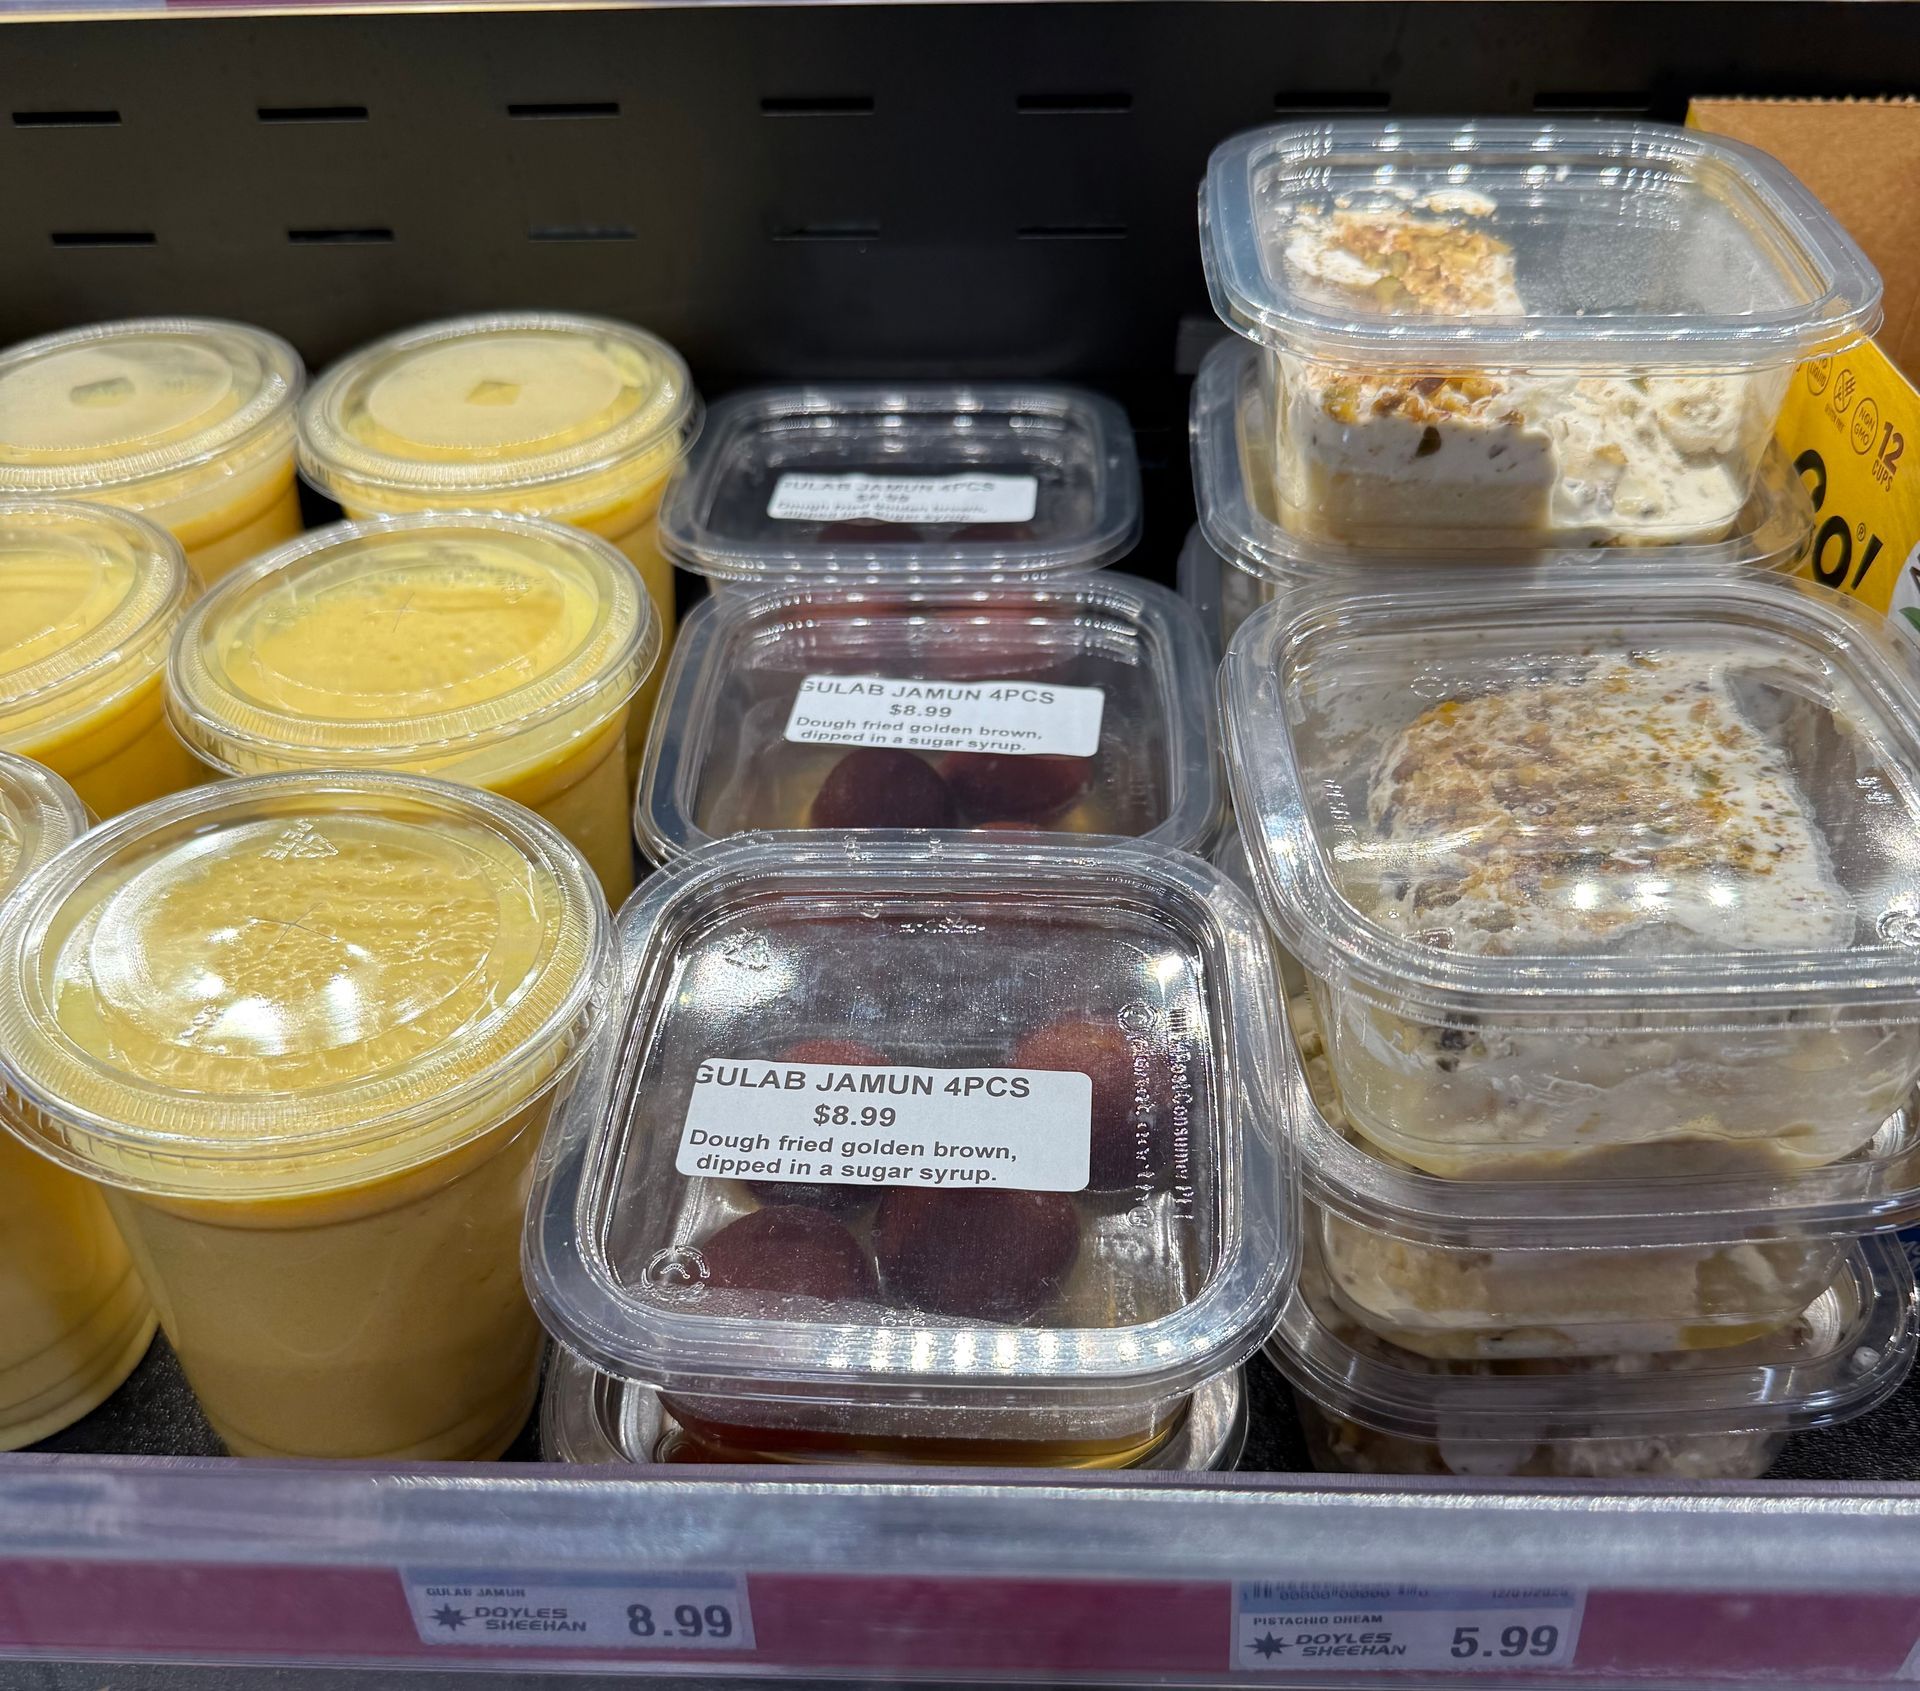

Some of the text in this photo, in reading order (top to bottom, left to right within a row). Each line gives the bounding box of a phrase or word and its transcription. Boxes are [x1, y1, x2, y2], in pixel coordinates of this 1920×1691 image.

[1858, 407, 1876, 432] NON
[1854, 423, 1871, 446] GMO
[1878, 421, 1904, 475] 12
[1871, 459, 1893, 493] CUPS
[799, 680, 1055, 704] GULAB JAMUN 4PCS
[889, 703, 952, 718] $8.99
[796, 716, 1043, 741] Dough fried golden brown,
[800, 729, 1027, 753] dipped in a sugar syrup.
[695, 1065, 1031, 1098] GULAB JAMUN 4PCS
[813, 1103, 897, 1128] $8.99
[689, 1128, 1018, 1163] Dough fried golden brown,
[696, 1154, 998, 1185] dipped in a sugar syrup.
[426, 1587, 526, 1598] GULAB JAMUN
[474, 1606, 568, 1619] DOYLES
[627, 1603, 733, 1638] 8.99
[1253, 1614, 1383, 1626] PISTACHIO DREAM
[485, 1619, 587, 1632] SHEEHAN
[1295, 1632, 1393, 1645] DOYLES
[1302, 1644, 1407, 1657] SHEEHAN
[1450, 1624, 1559, 1659] 5.99
